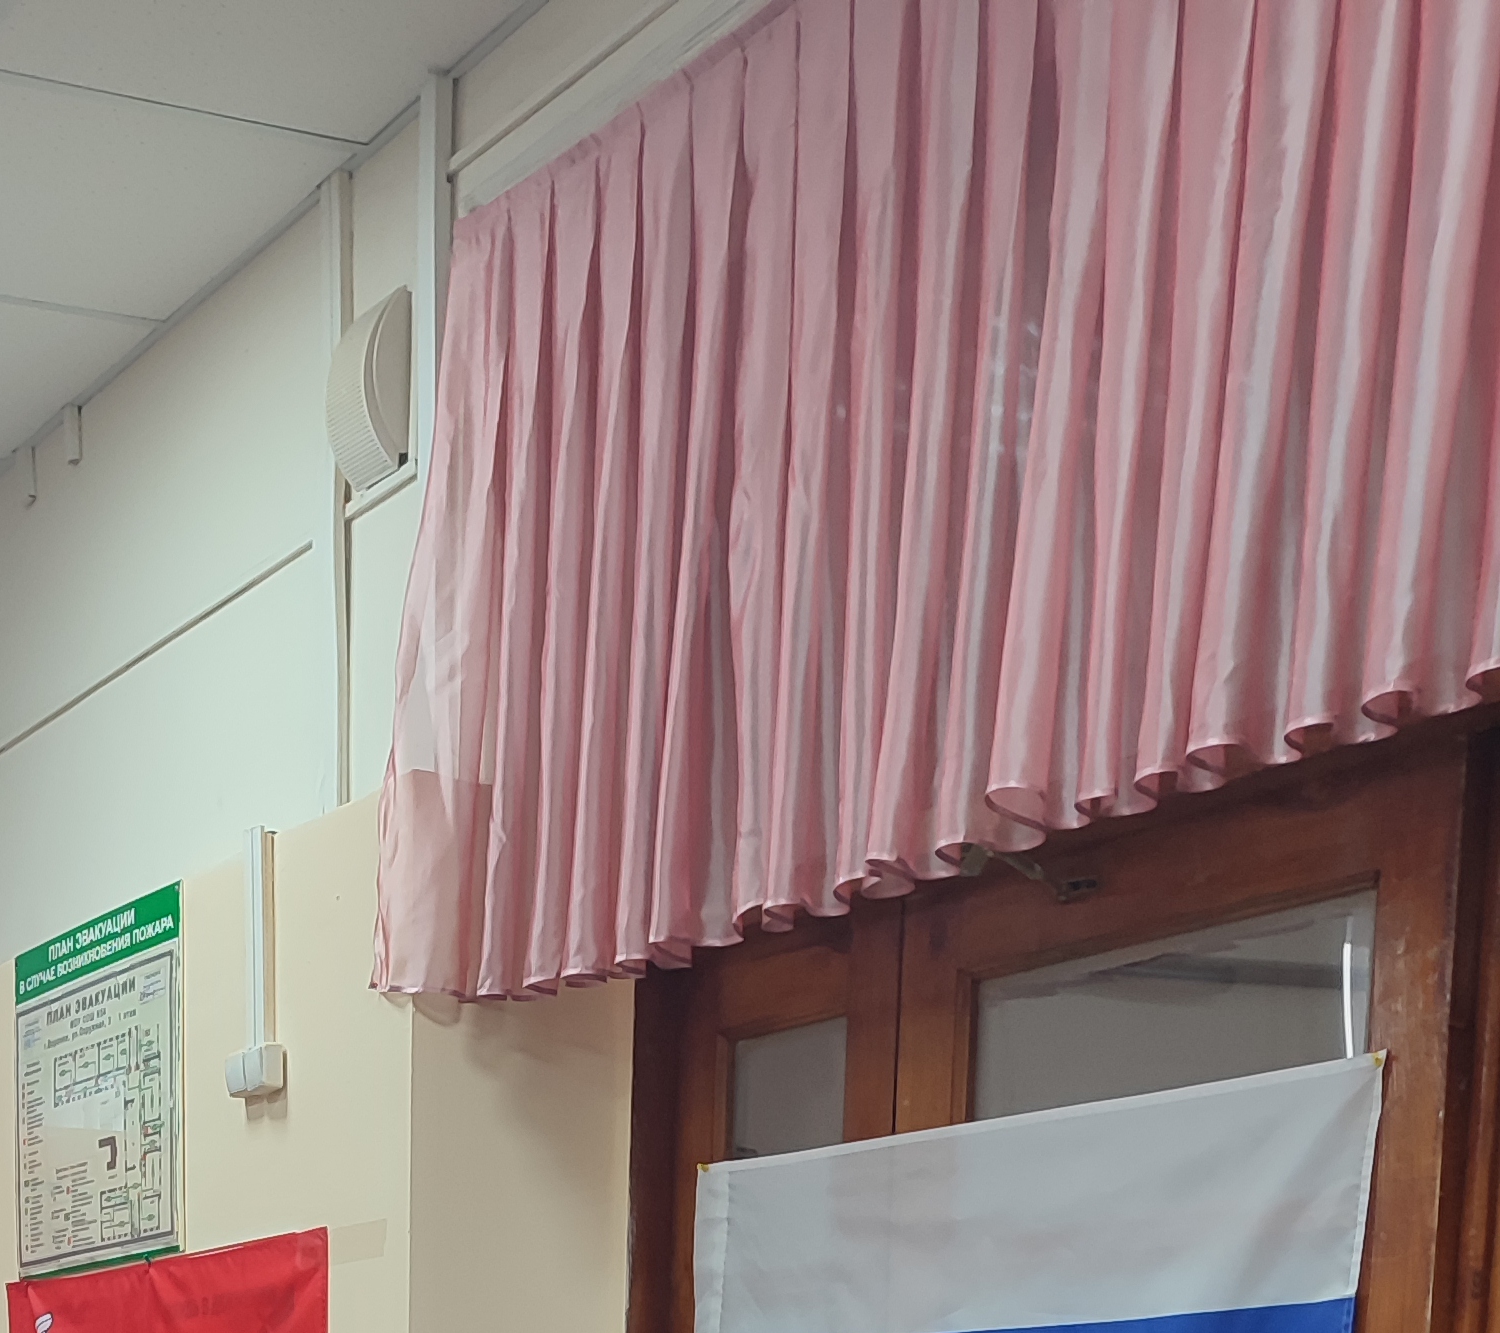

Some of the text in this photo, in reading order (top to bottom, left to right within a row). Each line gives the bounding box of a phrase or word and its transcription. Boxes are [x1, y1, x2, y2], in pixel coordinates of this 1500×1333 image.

[19, 914, 174, 995] В СЛУЧАЕ ВОЗНИКНОВЕНИЯ ПОЖАРА
[48, 908, 135, 962] ПЛАН ЭВАКУАЦИИ
[46, 1004, 71, 1026] ПЛАН
[74, 976, 136, 1014] ЭВАКУАЦИИ
